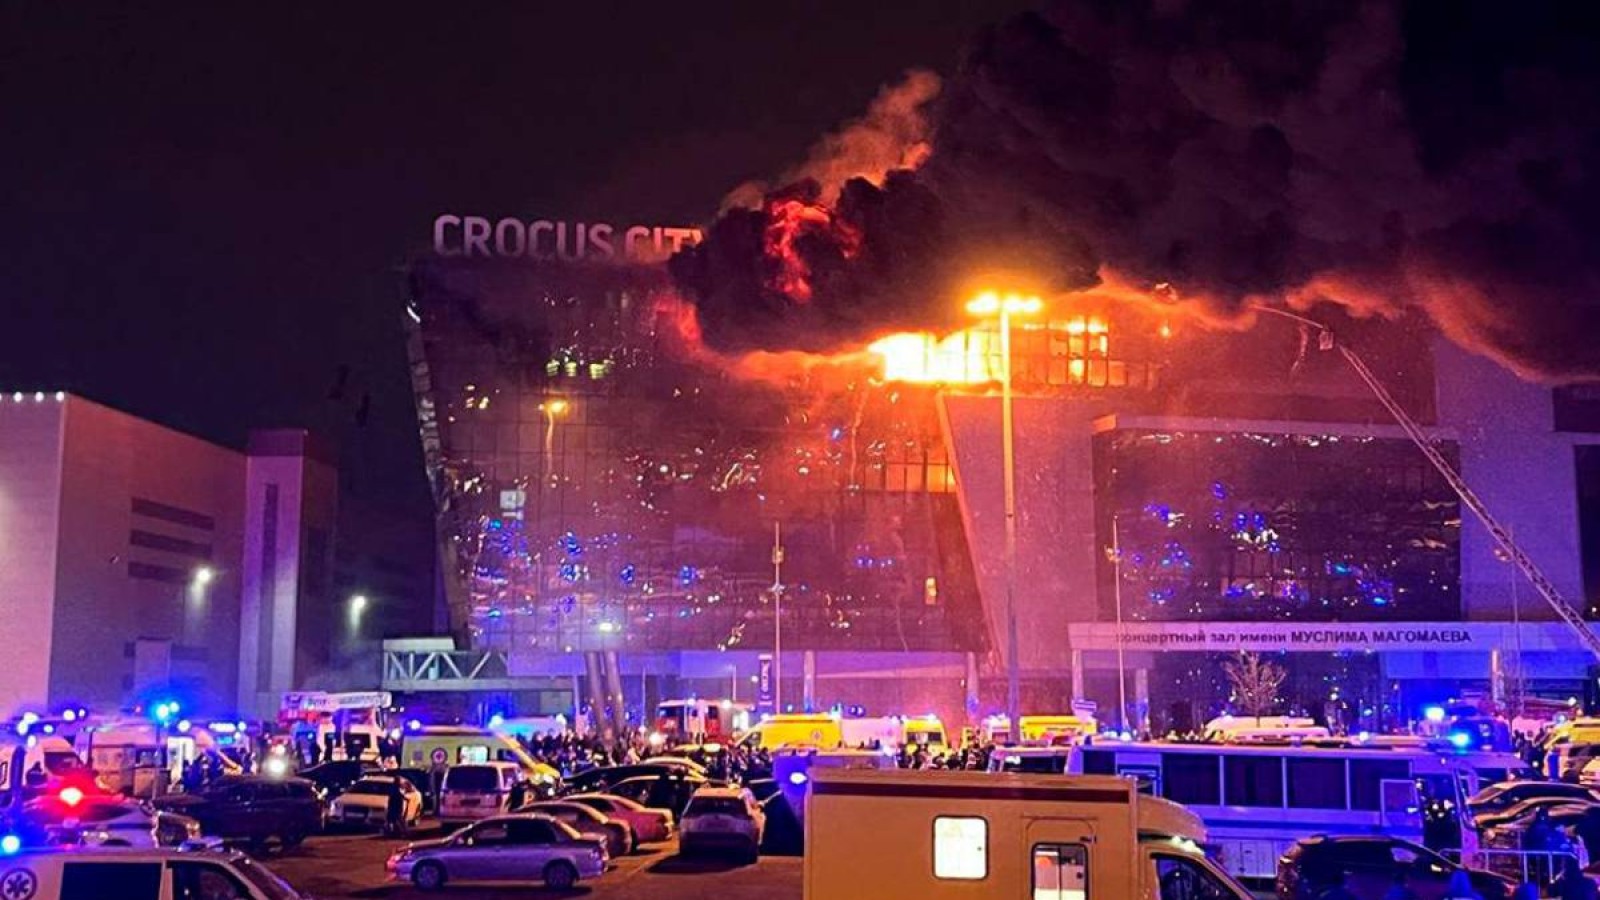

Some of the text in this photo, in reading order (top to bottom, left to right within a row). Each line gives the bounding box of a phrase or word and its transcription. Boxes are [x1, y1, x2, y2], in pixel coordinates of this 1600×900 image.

[433, 213, 615, 260] CROCUS
[1211, 632, 1236, 643] зал
[1240, 632, 1287, 643] имени
[1291, 630, 1369, 643] МУСЛИМА
[1372, 630, 1473, 643] МАГОМАЕВА
